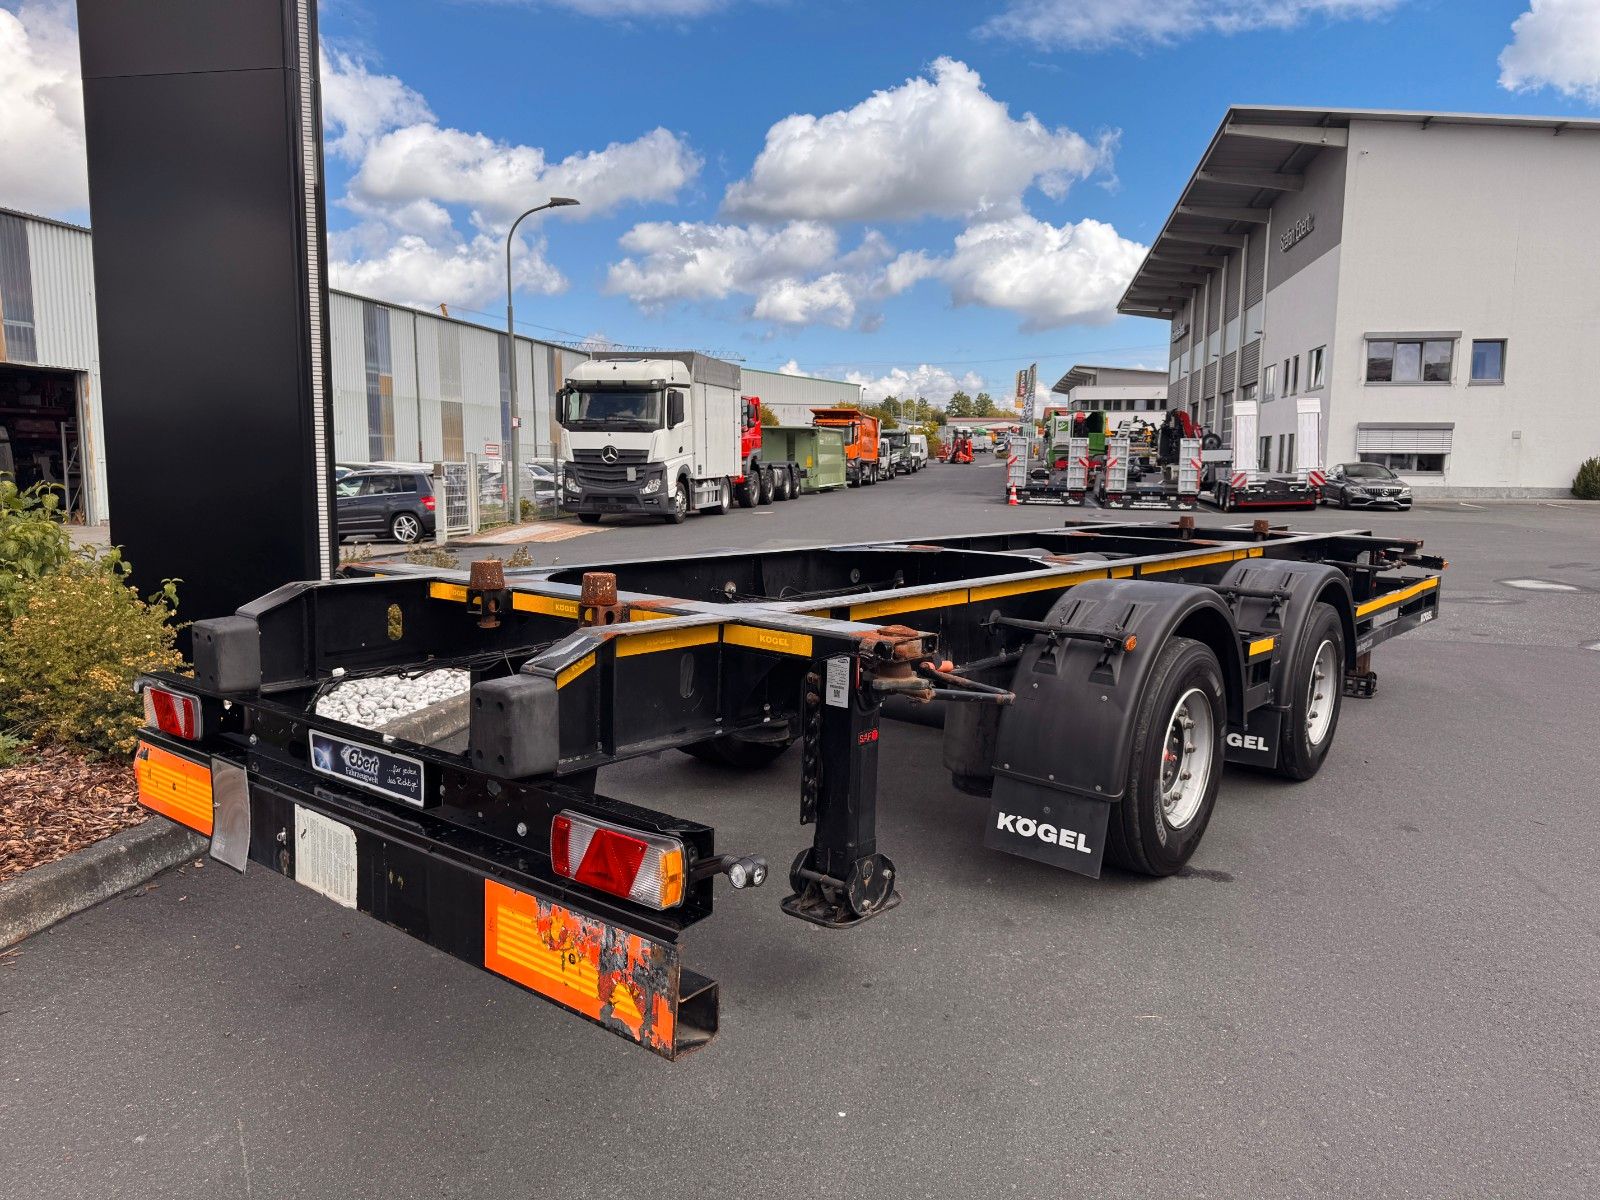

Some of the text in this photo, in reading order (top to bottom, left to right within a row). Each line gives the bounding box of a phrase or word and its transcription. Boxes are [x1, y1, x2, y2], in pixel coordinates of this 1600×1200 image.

[1227, 733, 1268, 751] GEL
[348, 748, 379, 774] Ebert
[996, 811, 1092, 854] KÖGEL
